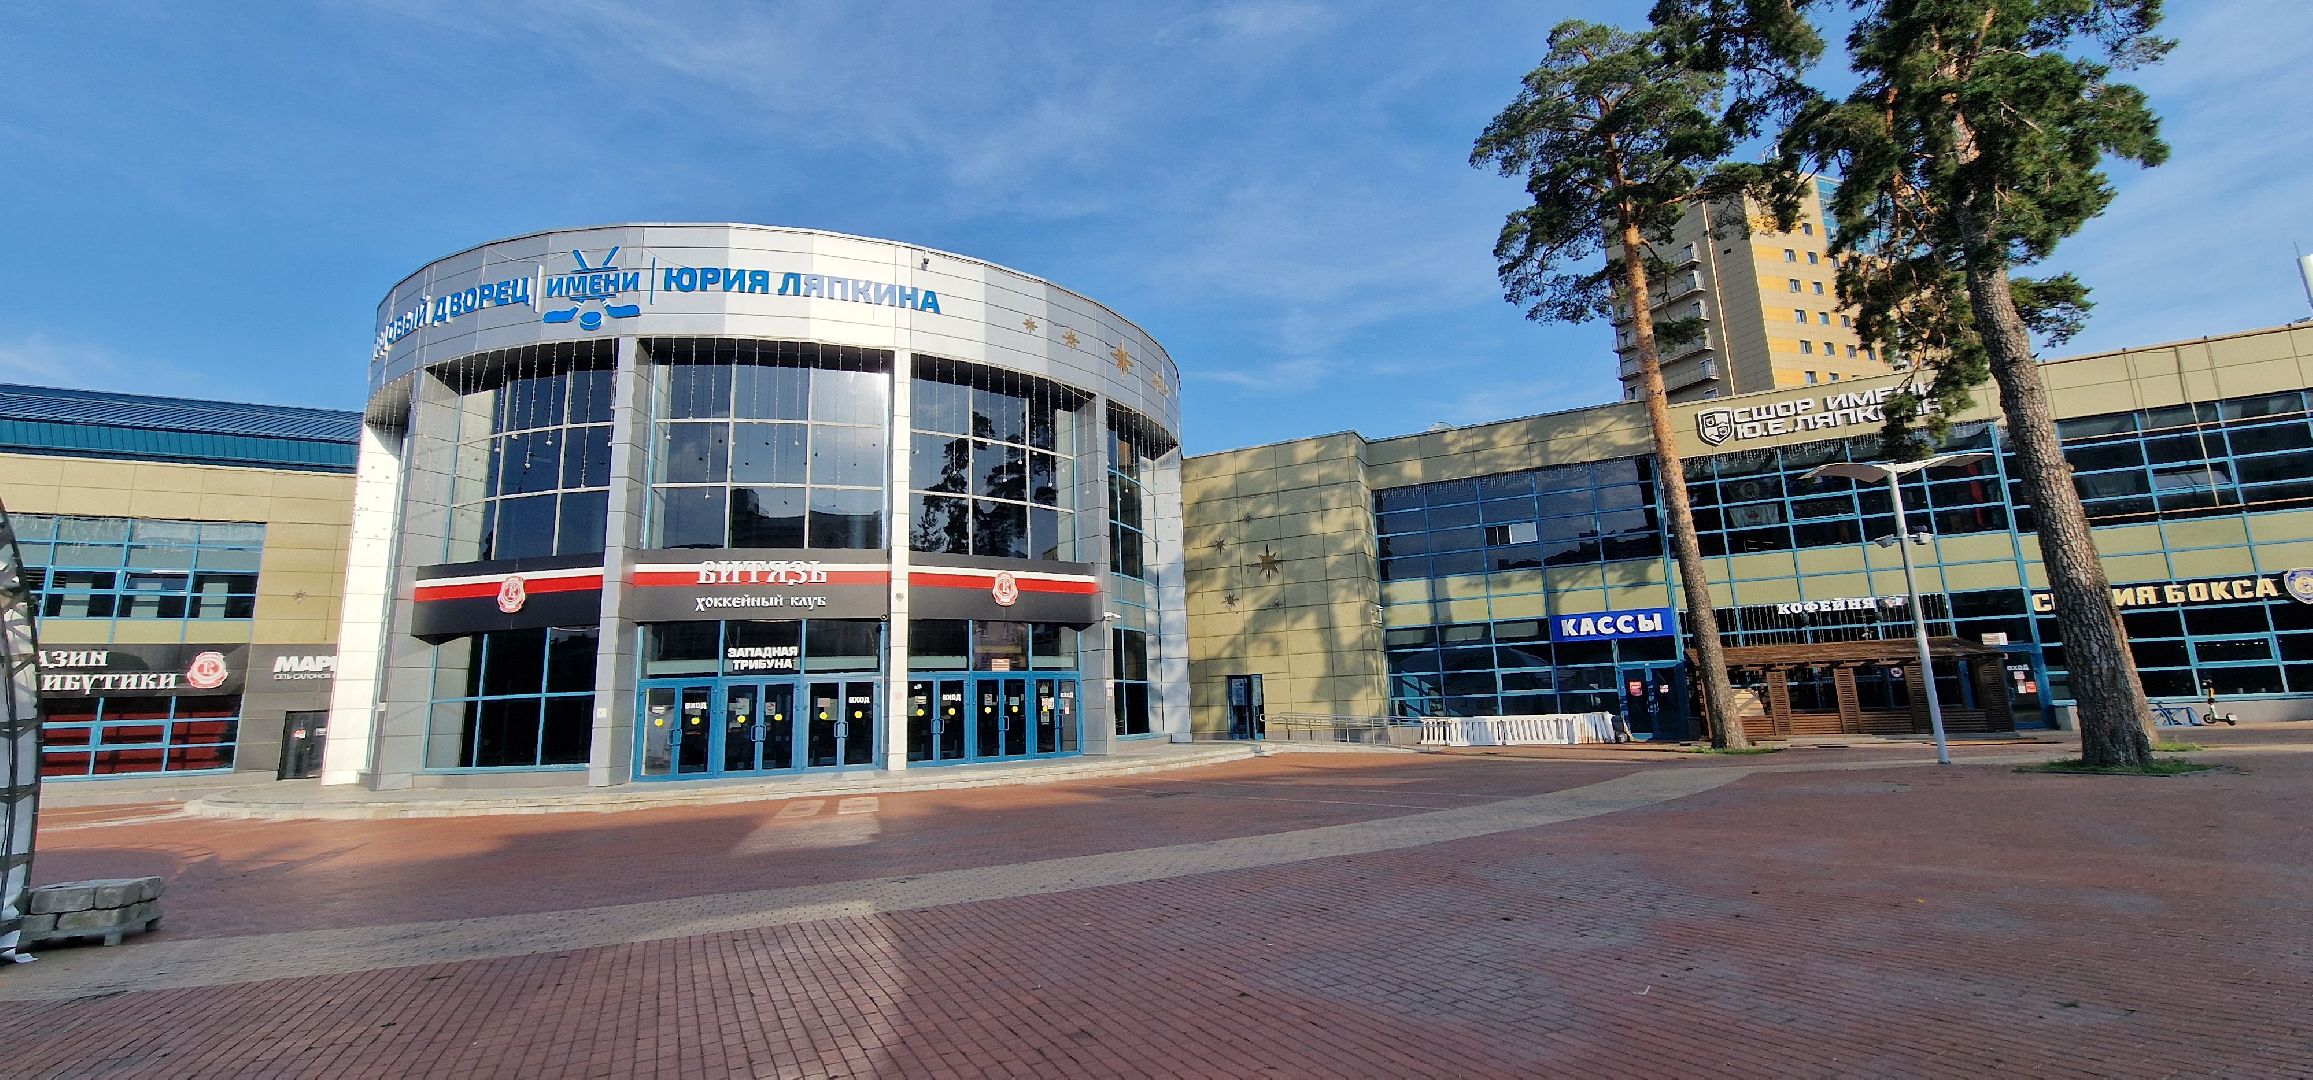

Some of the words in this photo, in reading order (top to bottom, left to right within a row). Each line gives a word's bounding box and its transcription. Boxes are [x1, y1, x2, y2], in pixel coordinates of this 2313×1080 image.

[546, 271, 640, 298] ИМЕНИ
[664, 266, 771, 293] ЮРИЯ
[777, 272, 942, 315] ЛЯПКИНА
[432, 277, 532, 327] ДВОРЕЦ
[1734, 398, 1815, 424] СШОР
[696, 560, 827, 586] ВИТЯЗЬ
[790, 596, 827, 610] клуб
[2164, 578, 2279, 604] БОКСА
[1777, 597, 1877, 615] КОФЕЙНЯ
[1561, 612, 1663, 638] КАССЫ
[38, 650, 110, 668] АЗИН
[727, 646, 798, 659] ЗАПАДНАЯ
[732, 659, 794, 671] ТРИБУНА
[40, 673, 178, 697] ИБУТИКИ
